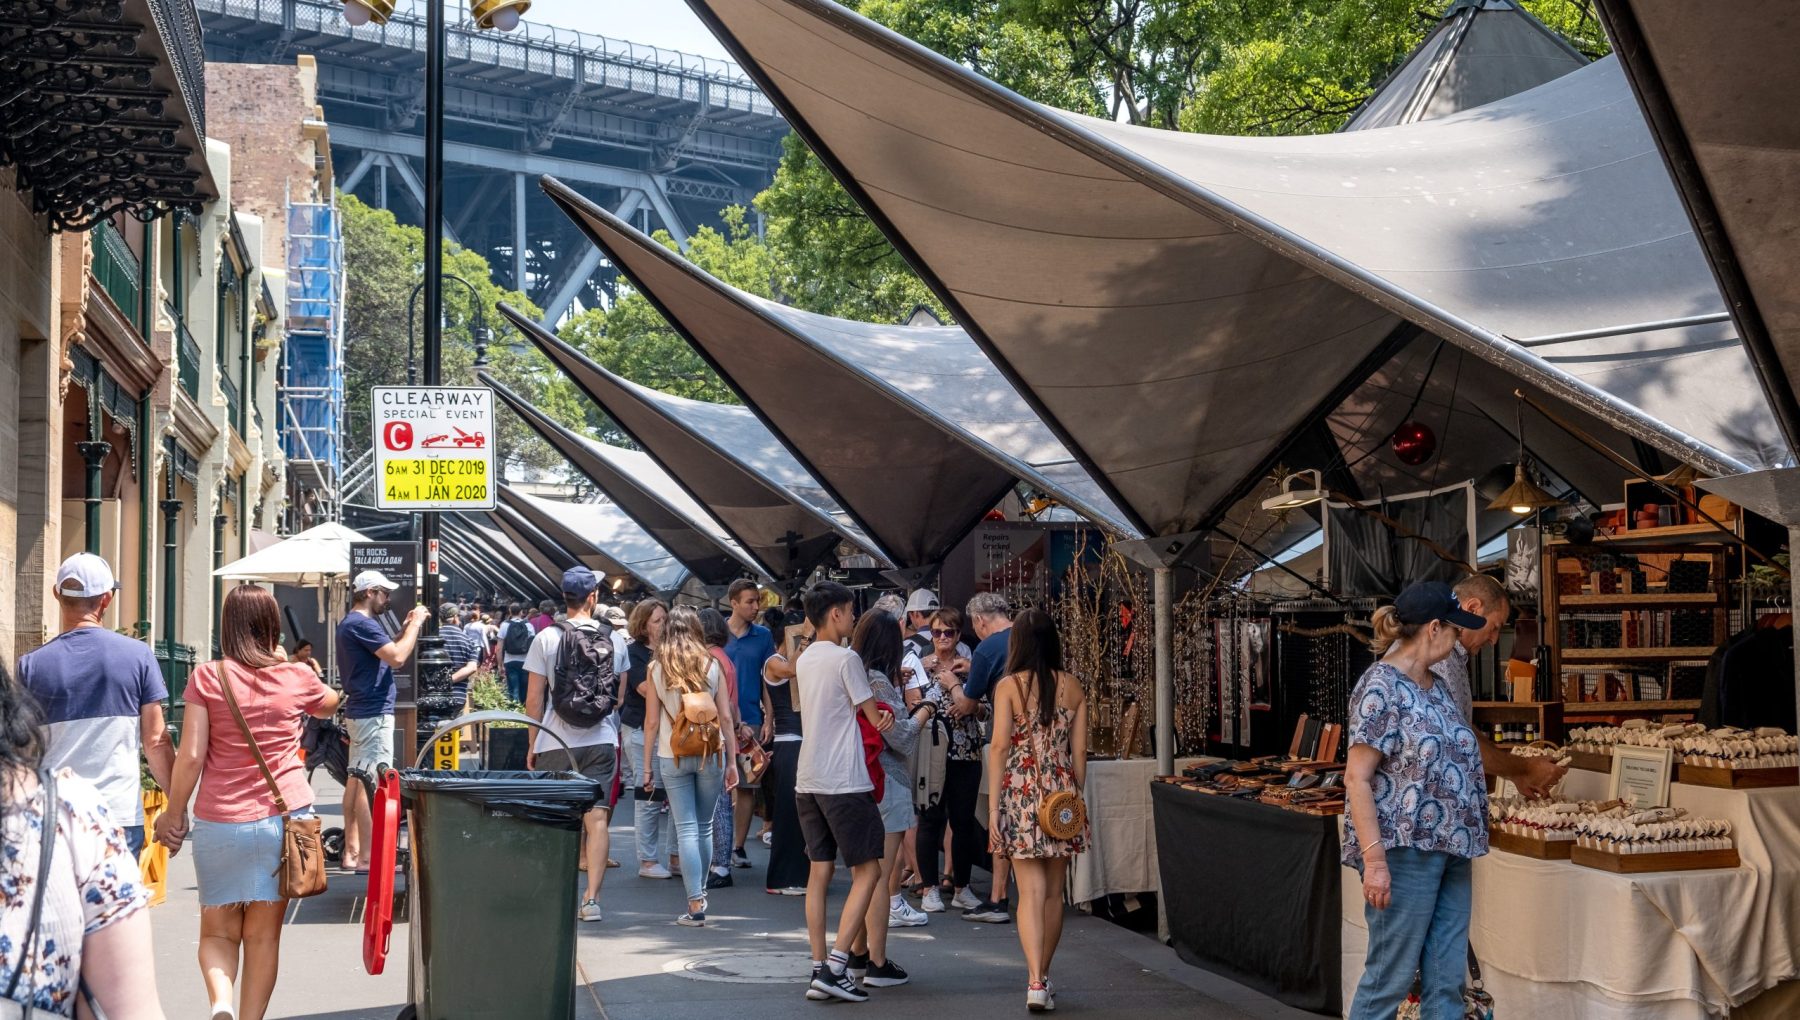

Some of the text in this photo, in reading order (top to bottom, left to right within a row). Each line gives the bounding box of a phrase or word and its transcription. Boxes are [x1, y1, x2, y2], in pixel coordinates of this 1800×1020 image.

[382, 392, 483, 405] CLEARWAY
[384, 410, 484, 419] SPECIAL EVENT
[390, 424, 406, 448] C
[386, 460, 485, 475] 6AM 31 DEC 2019
[429, 475, 444, 485] TO
[388, 485, 487, 500] 4AM 1 JAN 2020
[983, 533, 1009, 542] Repairs
[353, 548, 387, 556] THE ROCKS
